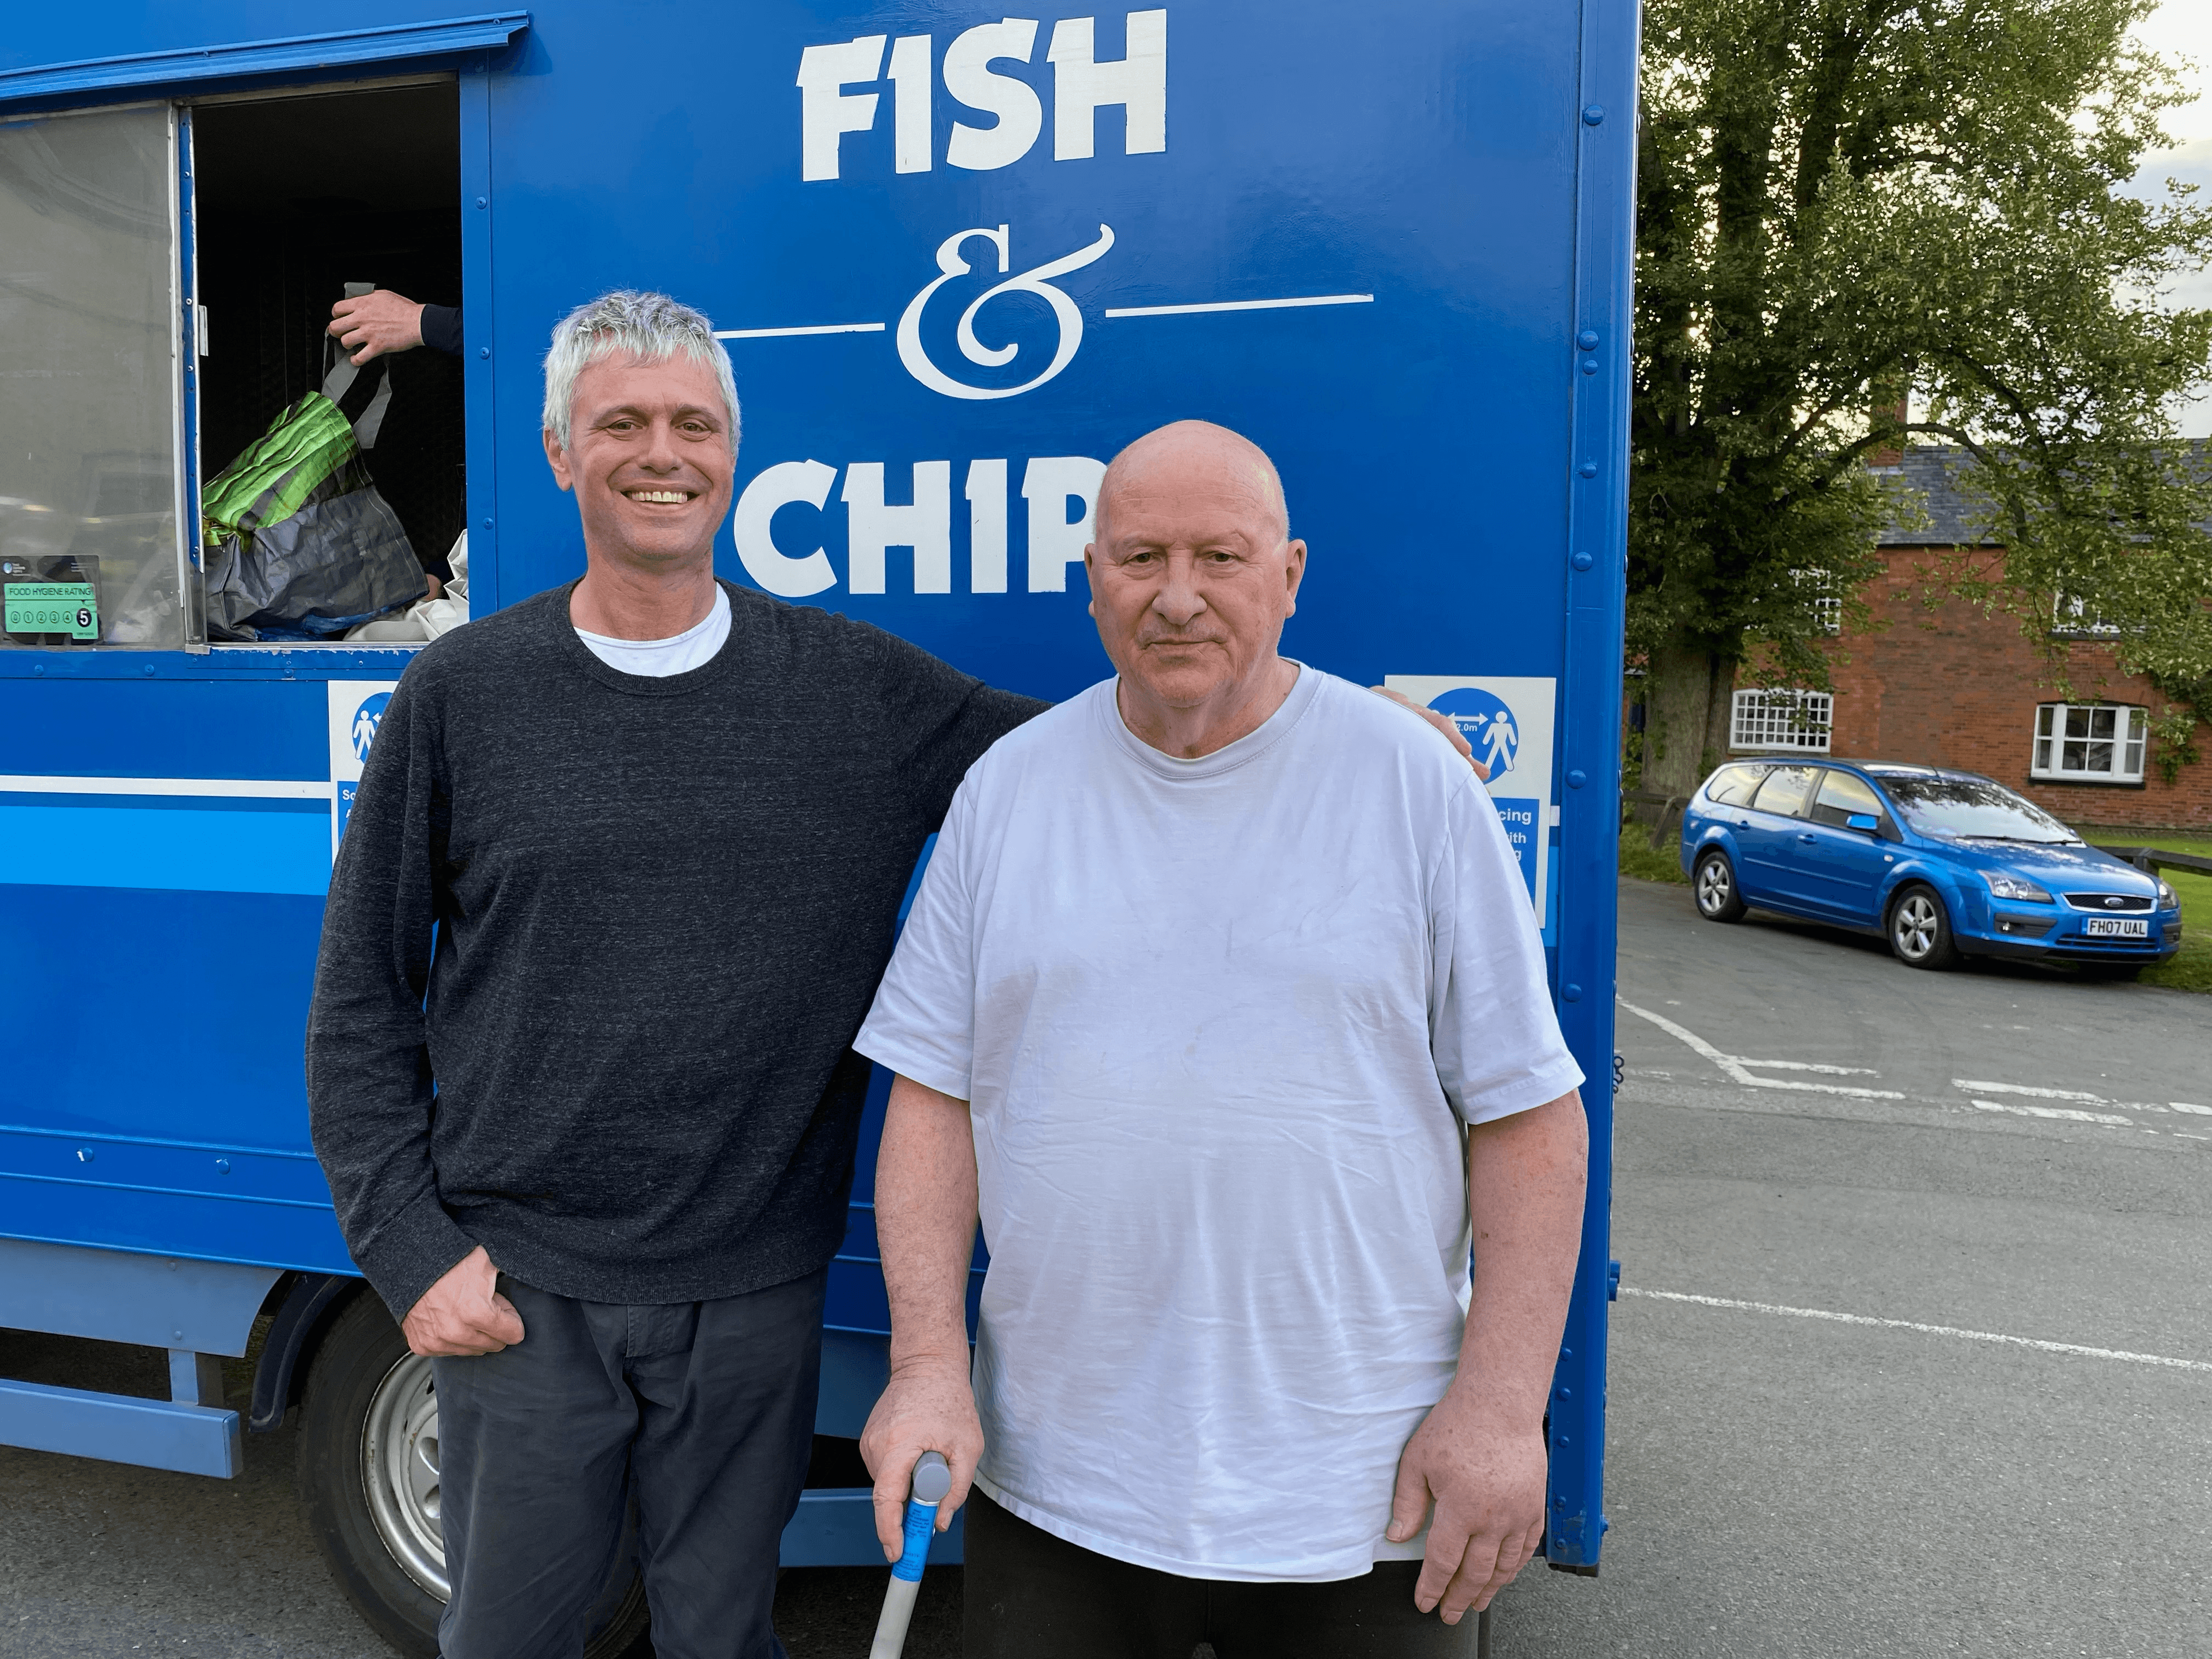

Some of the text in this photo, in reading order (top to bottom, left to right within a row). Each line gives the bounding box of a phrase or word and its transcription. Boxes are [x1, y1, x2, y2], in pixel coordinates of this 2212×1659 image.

[796, 9, 1166, 181] FISH
[897, 224, 1115, 399] &
[734, 456, 1107, 597] CHIP
[9, 588, 31, 596] FOOD
[65, 588, 92, 596] RATING
[79, 611, 89, 625] 5
[1508, 832, 1527, 844] ith
[2089, 920, 2145, 935] FH07 UAL
